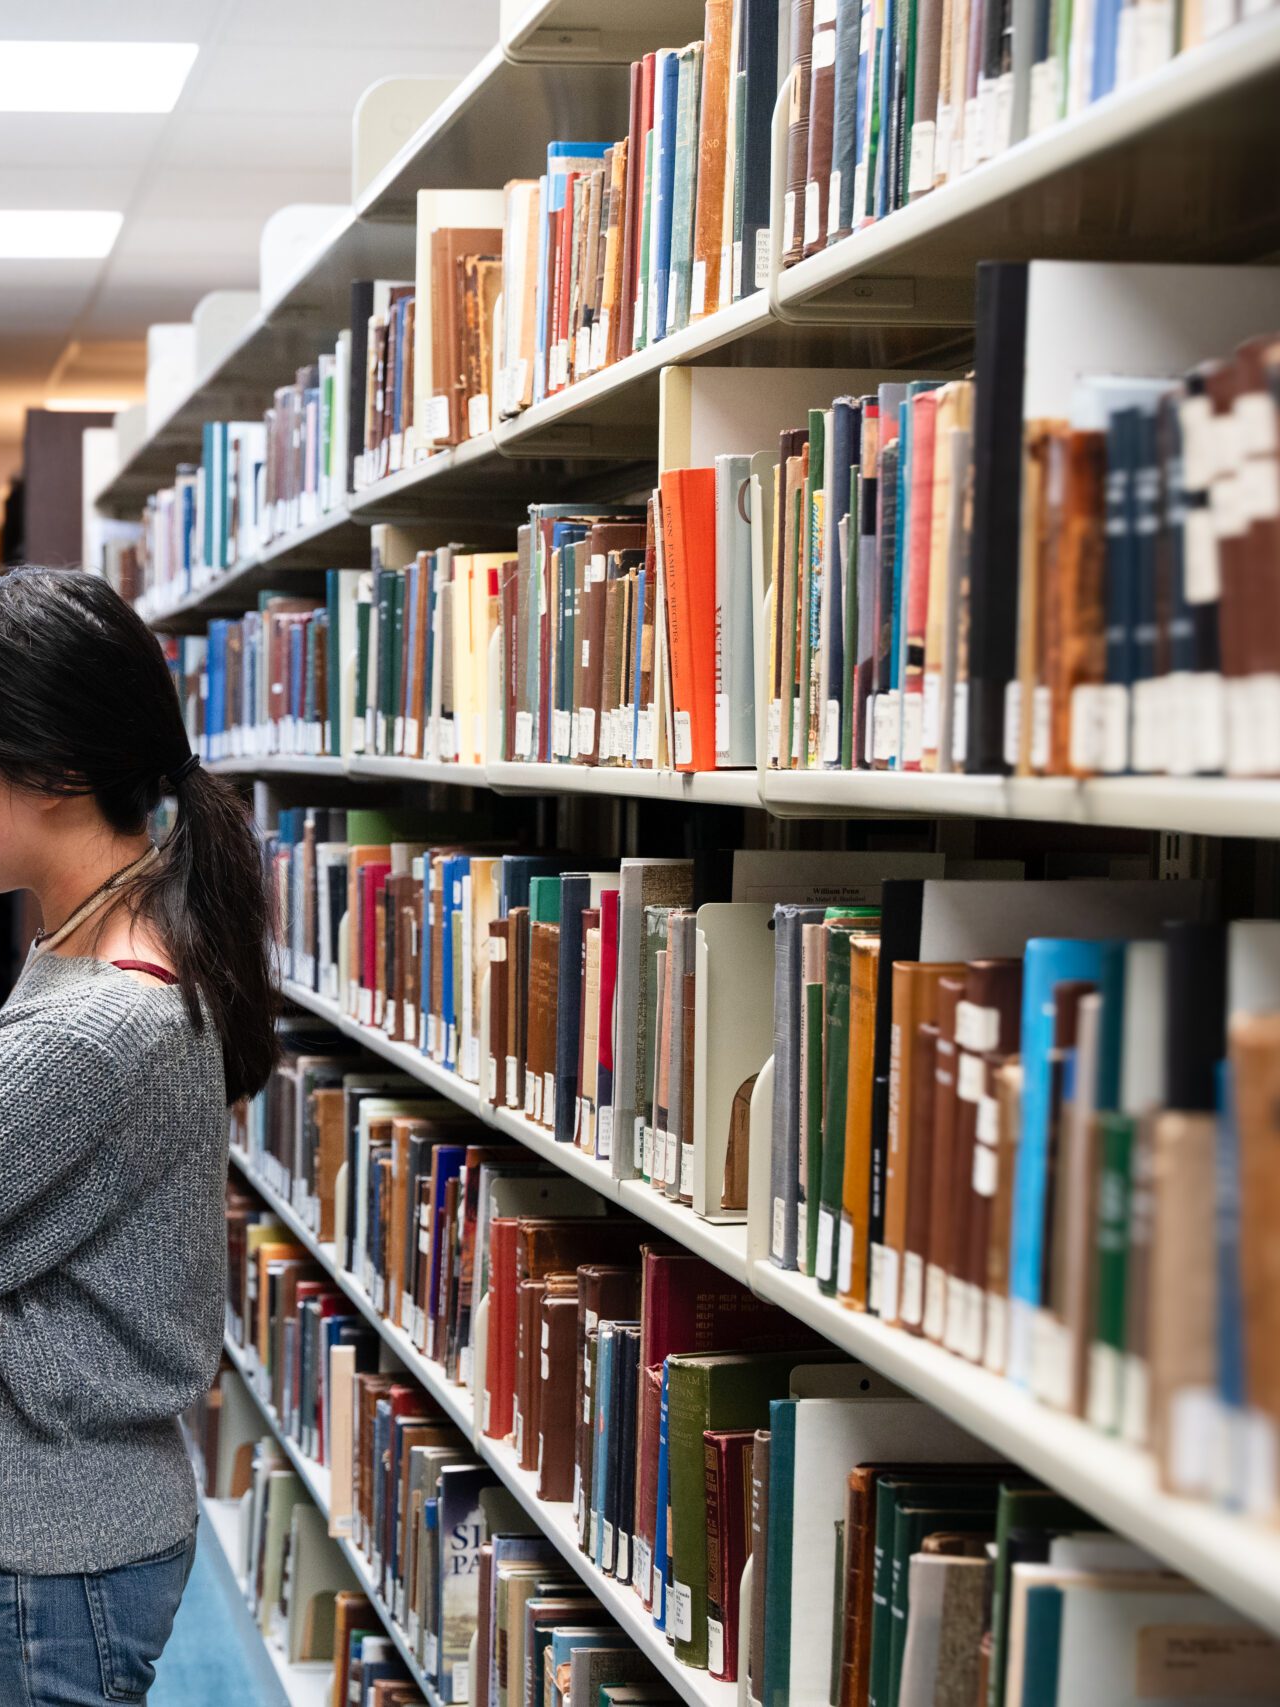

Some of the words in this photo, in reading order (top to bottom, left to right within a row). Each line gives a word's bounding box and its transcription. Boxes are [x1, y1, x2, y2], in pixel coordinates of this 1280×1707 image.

[665, 506, 673, 538] PENN
[667, 543, 676, 591] FAMILY
[670, 596, 679, 645] RECIPES
[813, 887, 840, 895] William
[842, 887, 859, 896] Penn
